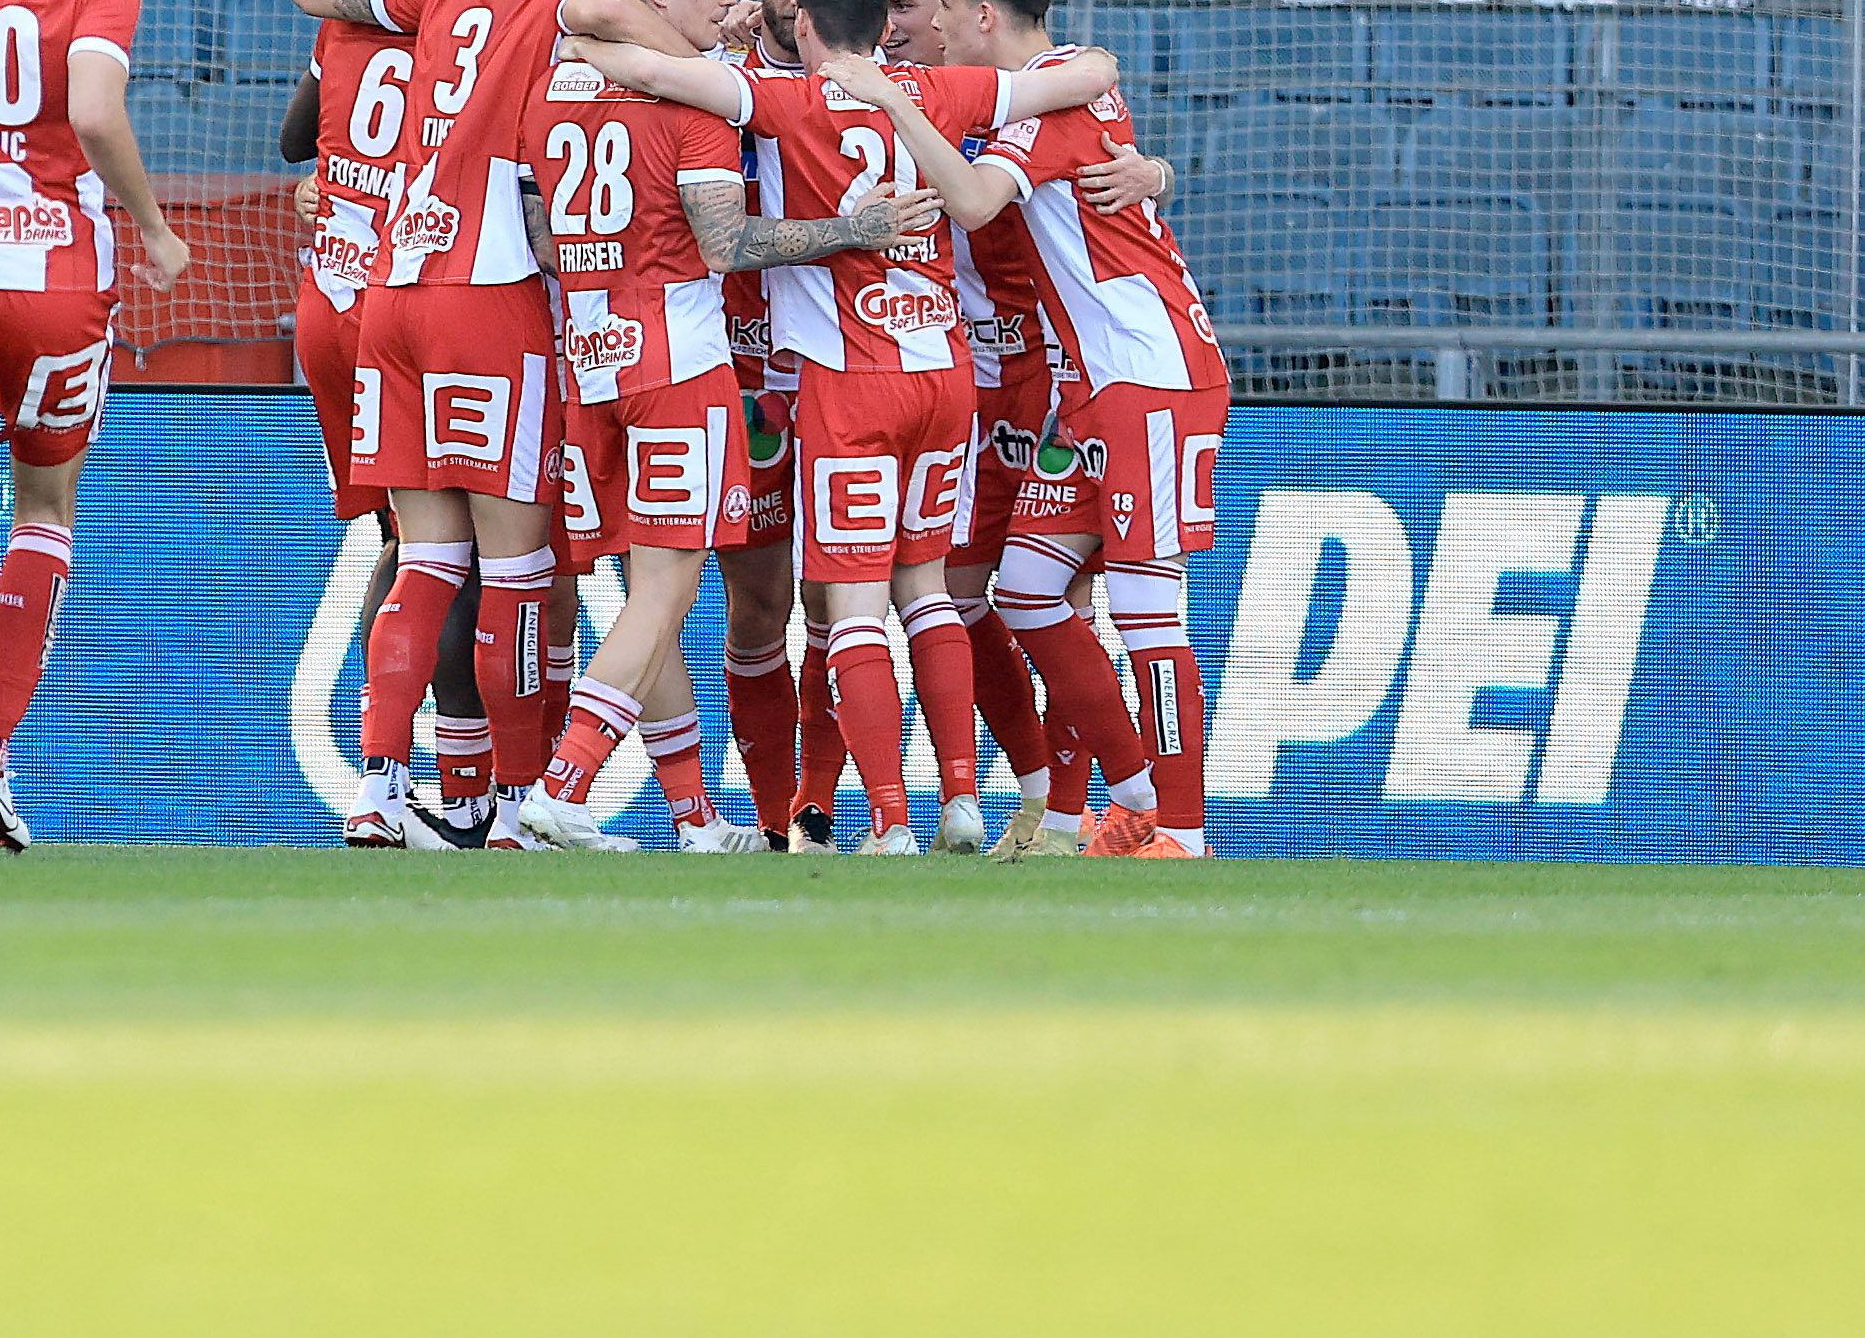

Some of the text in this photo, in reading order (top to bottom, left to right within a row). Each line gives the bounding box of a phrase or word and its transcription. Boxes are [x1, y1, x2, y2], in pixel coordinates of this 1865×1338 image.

[433, 7, 493, 115] 3
[349, 47, 414, 158] 6
[553, 80, 598, 92] SORGER
[327, 153, 397, 199] FOFANA
[546, 120, 634, 237] 28
[24, 228, 68, 241] DRINKS
[449, 456, 499, 473] STEIERMARK
[652, 516, 703, 527] STEIERMARK
[1111, 492, 1134, 512] 18
[526, 612, 541, 691] ENERGIE GRAZ
[1163, 668, 1180, 752] ENERGIE GRAZ
